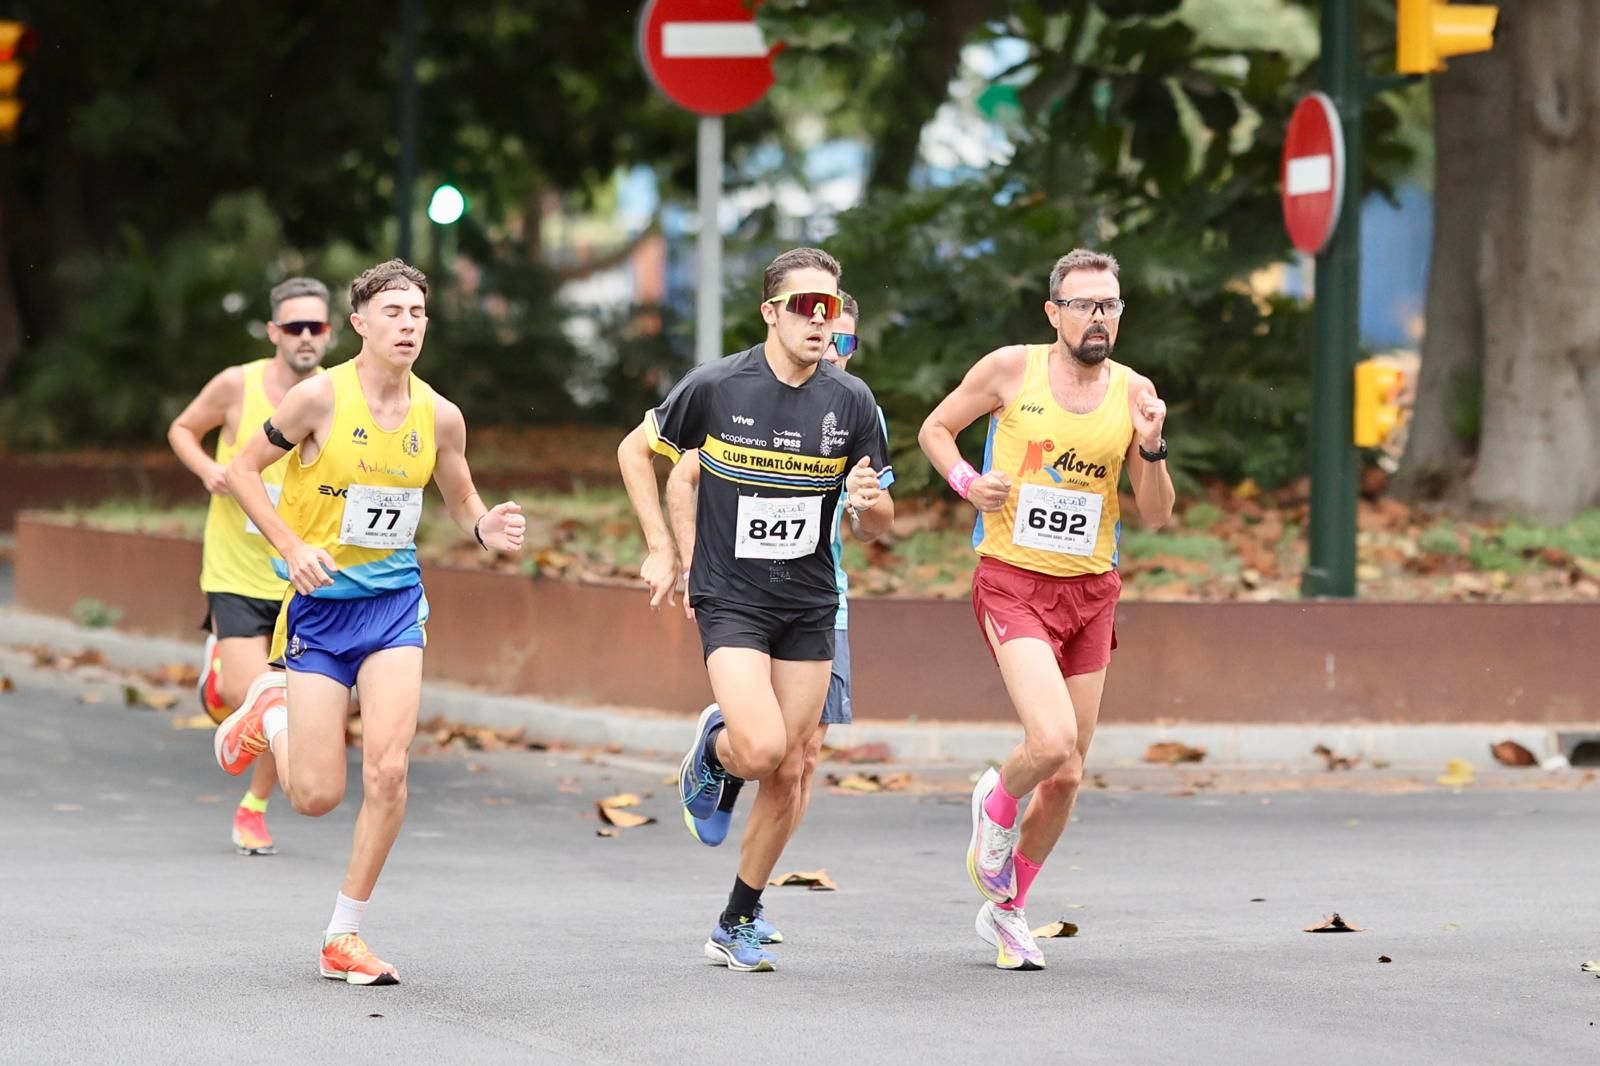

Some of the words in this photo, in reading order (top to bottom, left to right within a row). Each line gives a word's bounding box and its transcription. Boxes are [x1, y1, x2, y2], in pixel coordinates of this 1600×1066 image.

[1020, 402, 1045, 415] vive
[732, 415, 754, 426] vive
[725, 434, 767, 447] copicentro
[773, 437, 801, 448] gress
[722, 450, 747, 464] CLUB
[750, 456, 801, 471] TRIATLÓN
[804, 461, 837, 474] MÁLAG
[1052, 447, 1107, 479] Álora
[367, 508, 401, 530] 77
[749, 518, 806, 540] 847
[1028, 507, 1087, 536] 692
